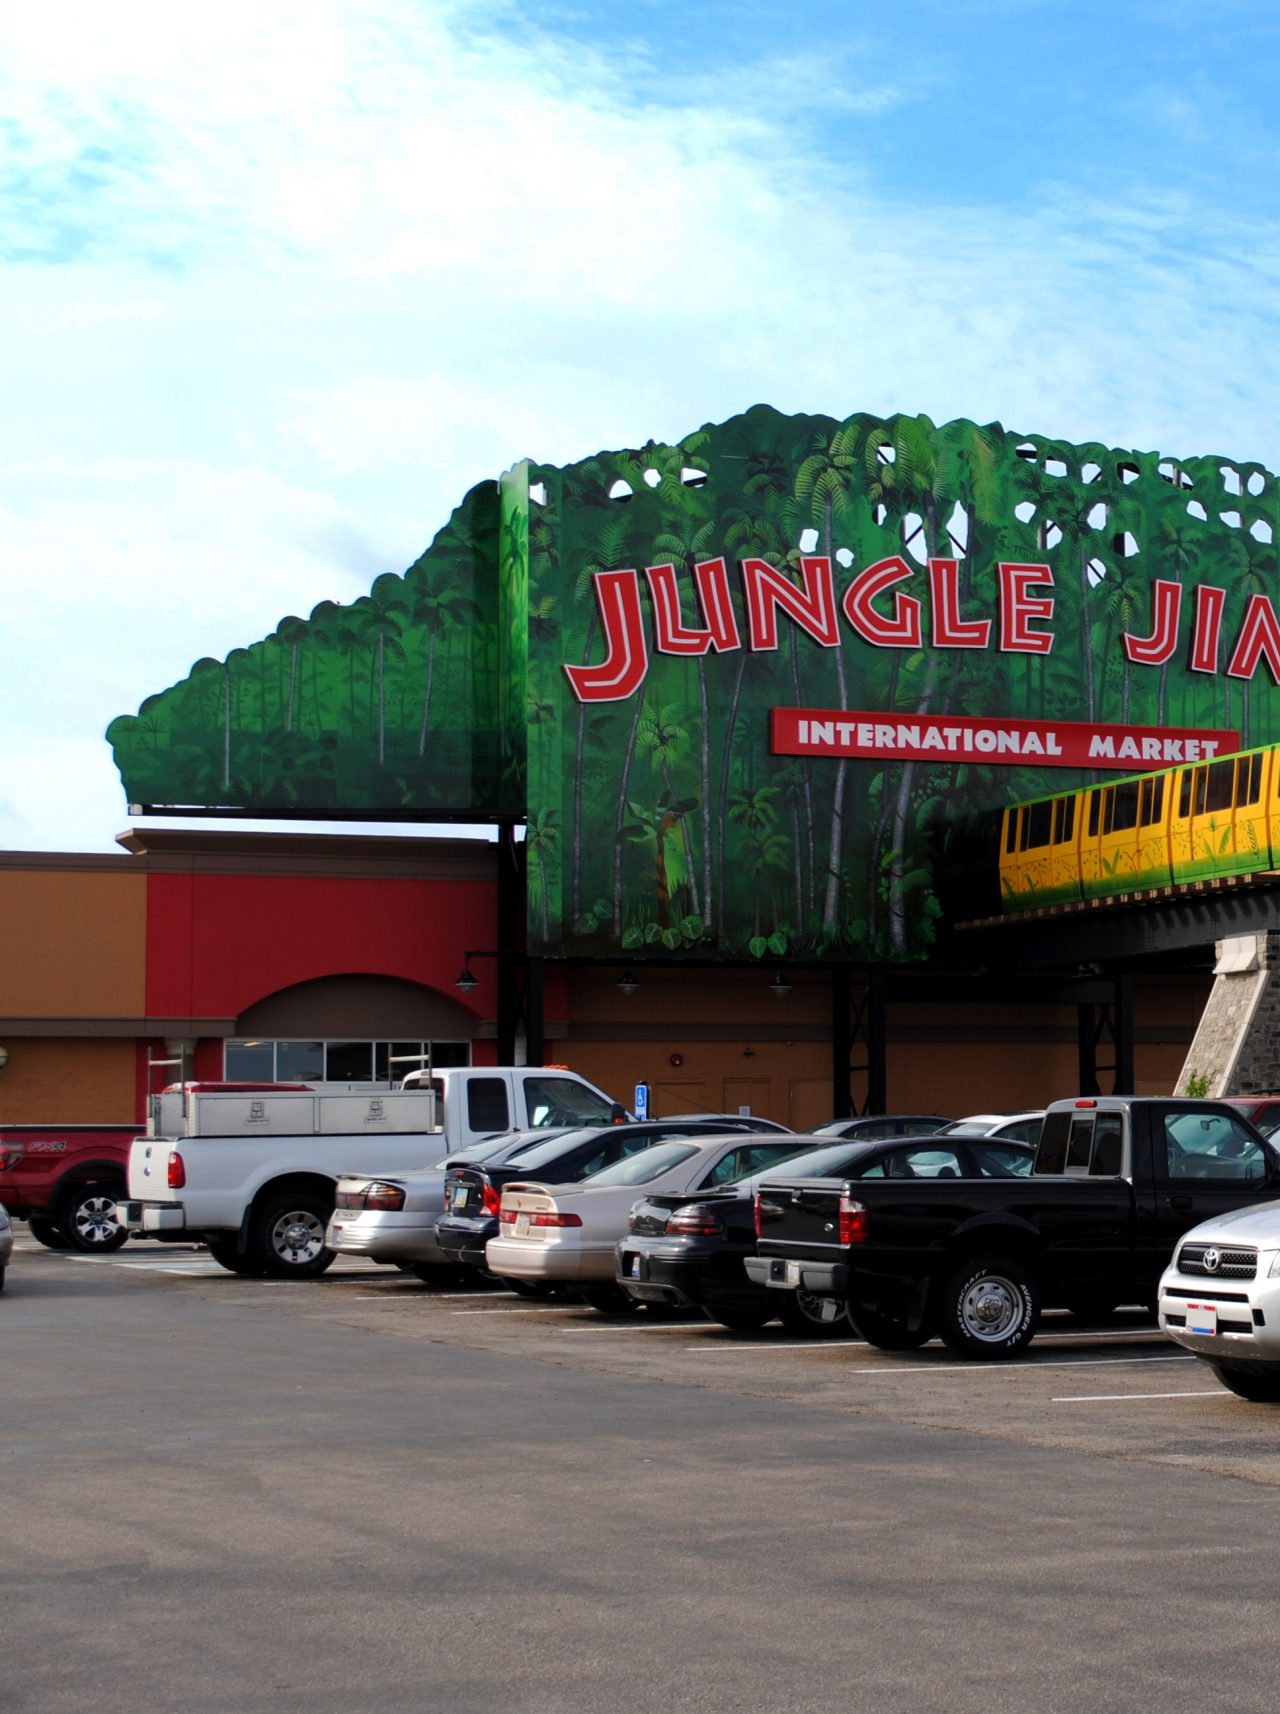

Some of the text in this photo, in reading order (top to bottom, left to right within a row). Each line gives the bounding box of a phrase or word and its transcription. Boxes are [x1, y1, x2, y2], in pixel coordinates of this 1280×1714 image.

[563, 556, 1056, 703] JUNGLE
[798, 719, 1219, 762] INTERNATIONAL MARKET
[1019, 1284, 1032, 1331] AVENGER
